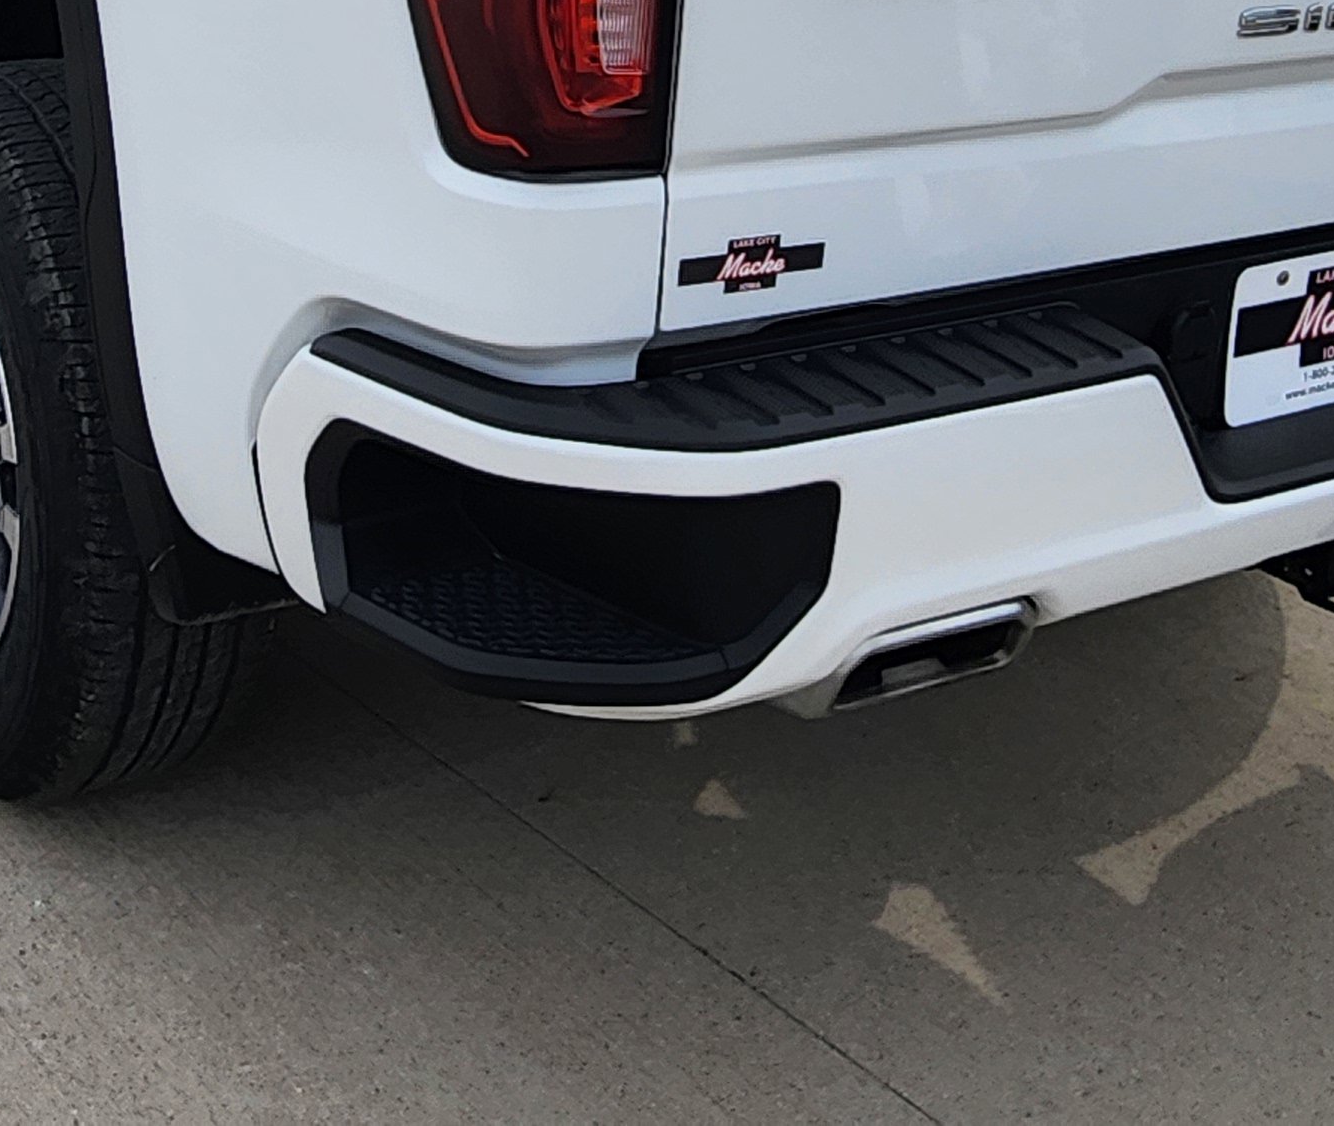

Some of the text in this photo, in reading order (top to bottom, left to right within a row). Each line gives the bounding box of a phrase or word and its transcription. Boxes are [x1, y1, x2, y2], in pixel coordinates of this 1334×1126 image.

[733, 235, 777, 249] LAKE CITY
[716, 247, 786, 280] Macke
